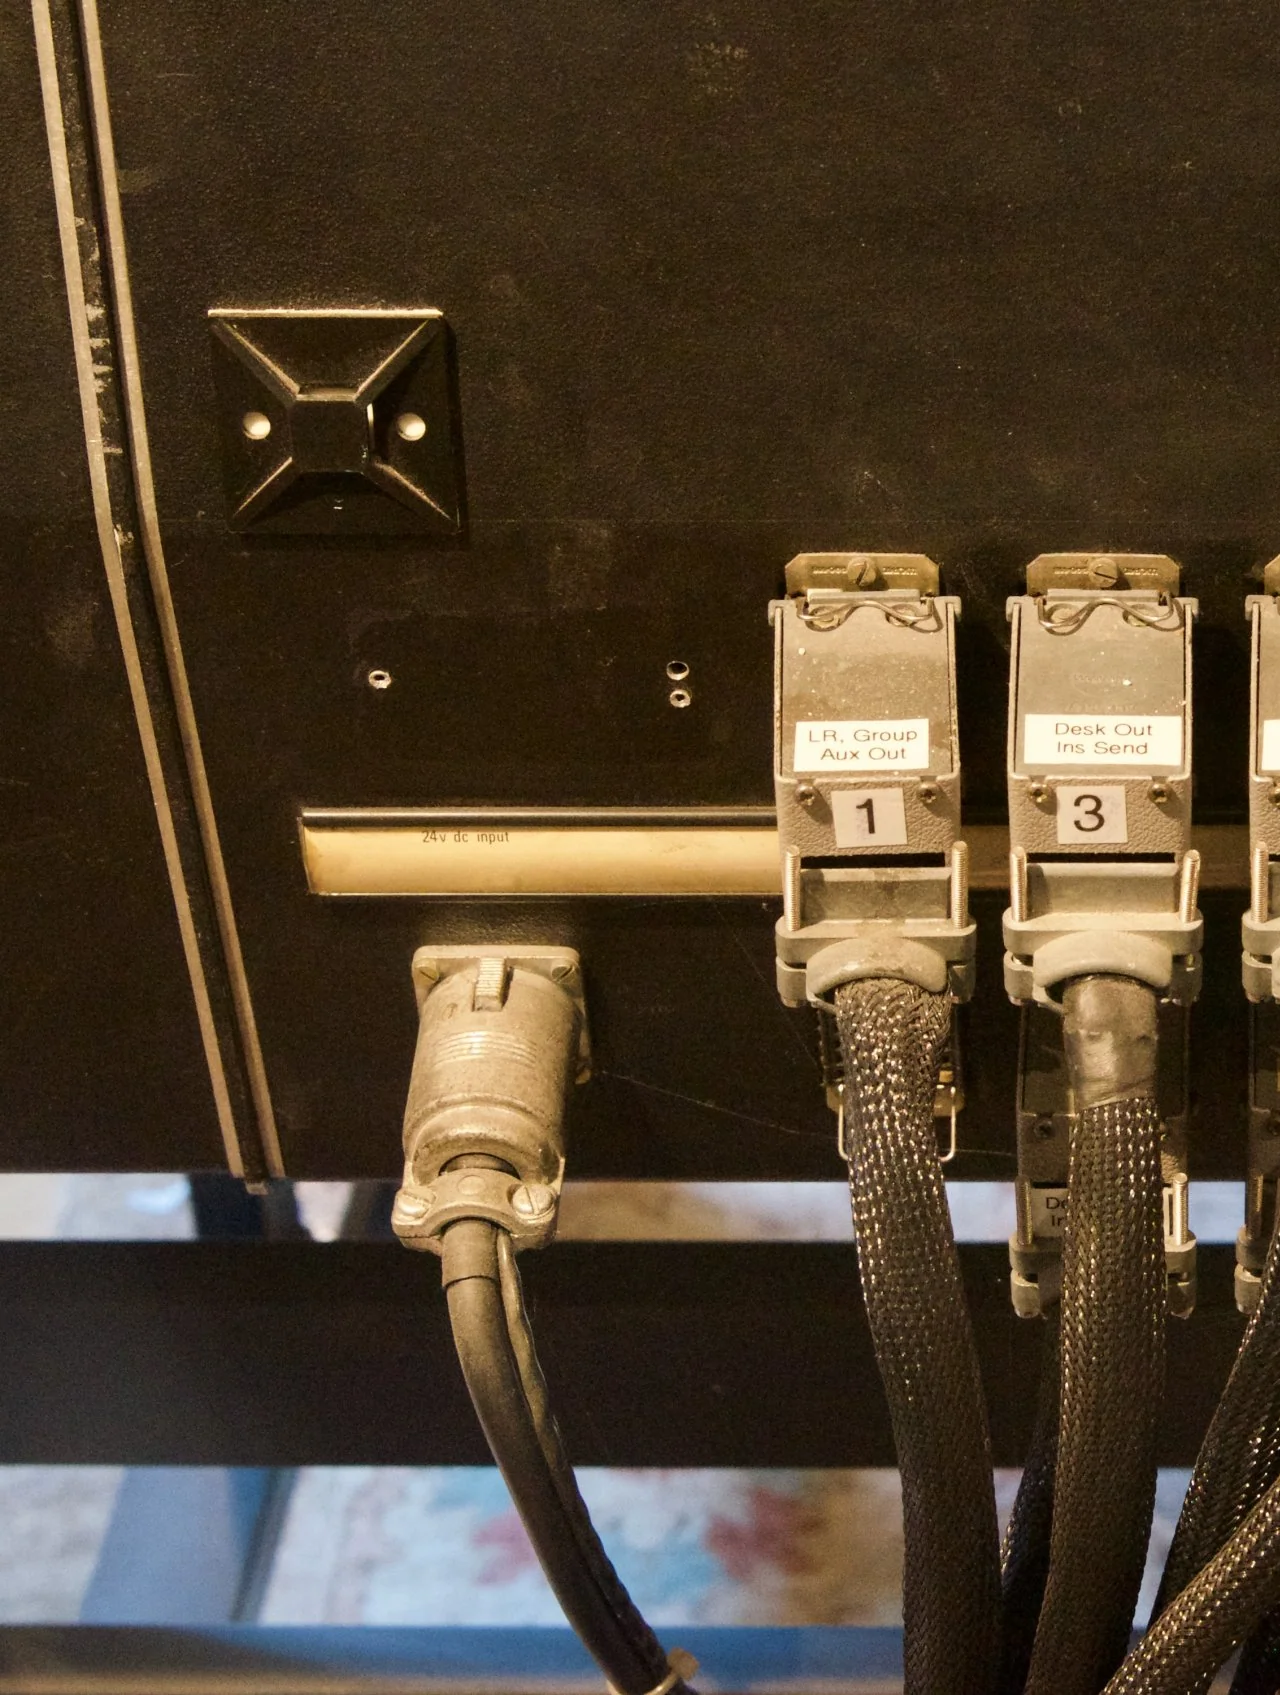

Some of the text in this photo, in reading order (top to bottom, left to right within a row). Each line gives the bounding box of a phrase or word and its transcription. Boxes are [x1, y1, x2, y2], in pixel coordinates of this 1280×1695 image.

[1056, 723, 1152, 736] Desk Out
[809, 730, 917, 743] LR, Group
[821, 748, 904, 760] Aux Out
[1058, 742, 1147, 754] Ins Send
[856, 799, 875, 834] 1
[1074, 795, 1104, 832] 3
[422, 830, 510, 845] 24v dc input
